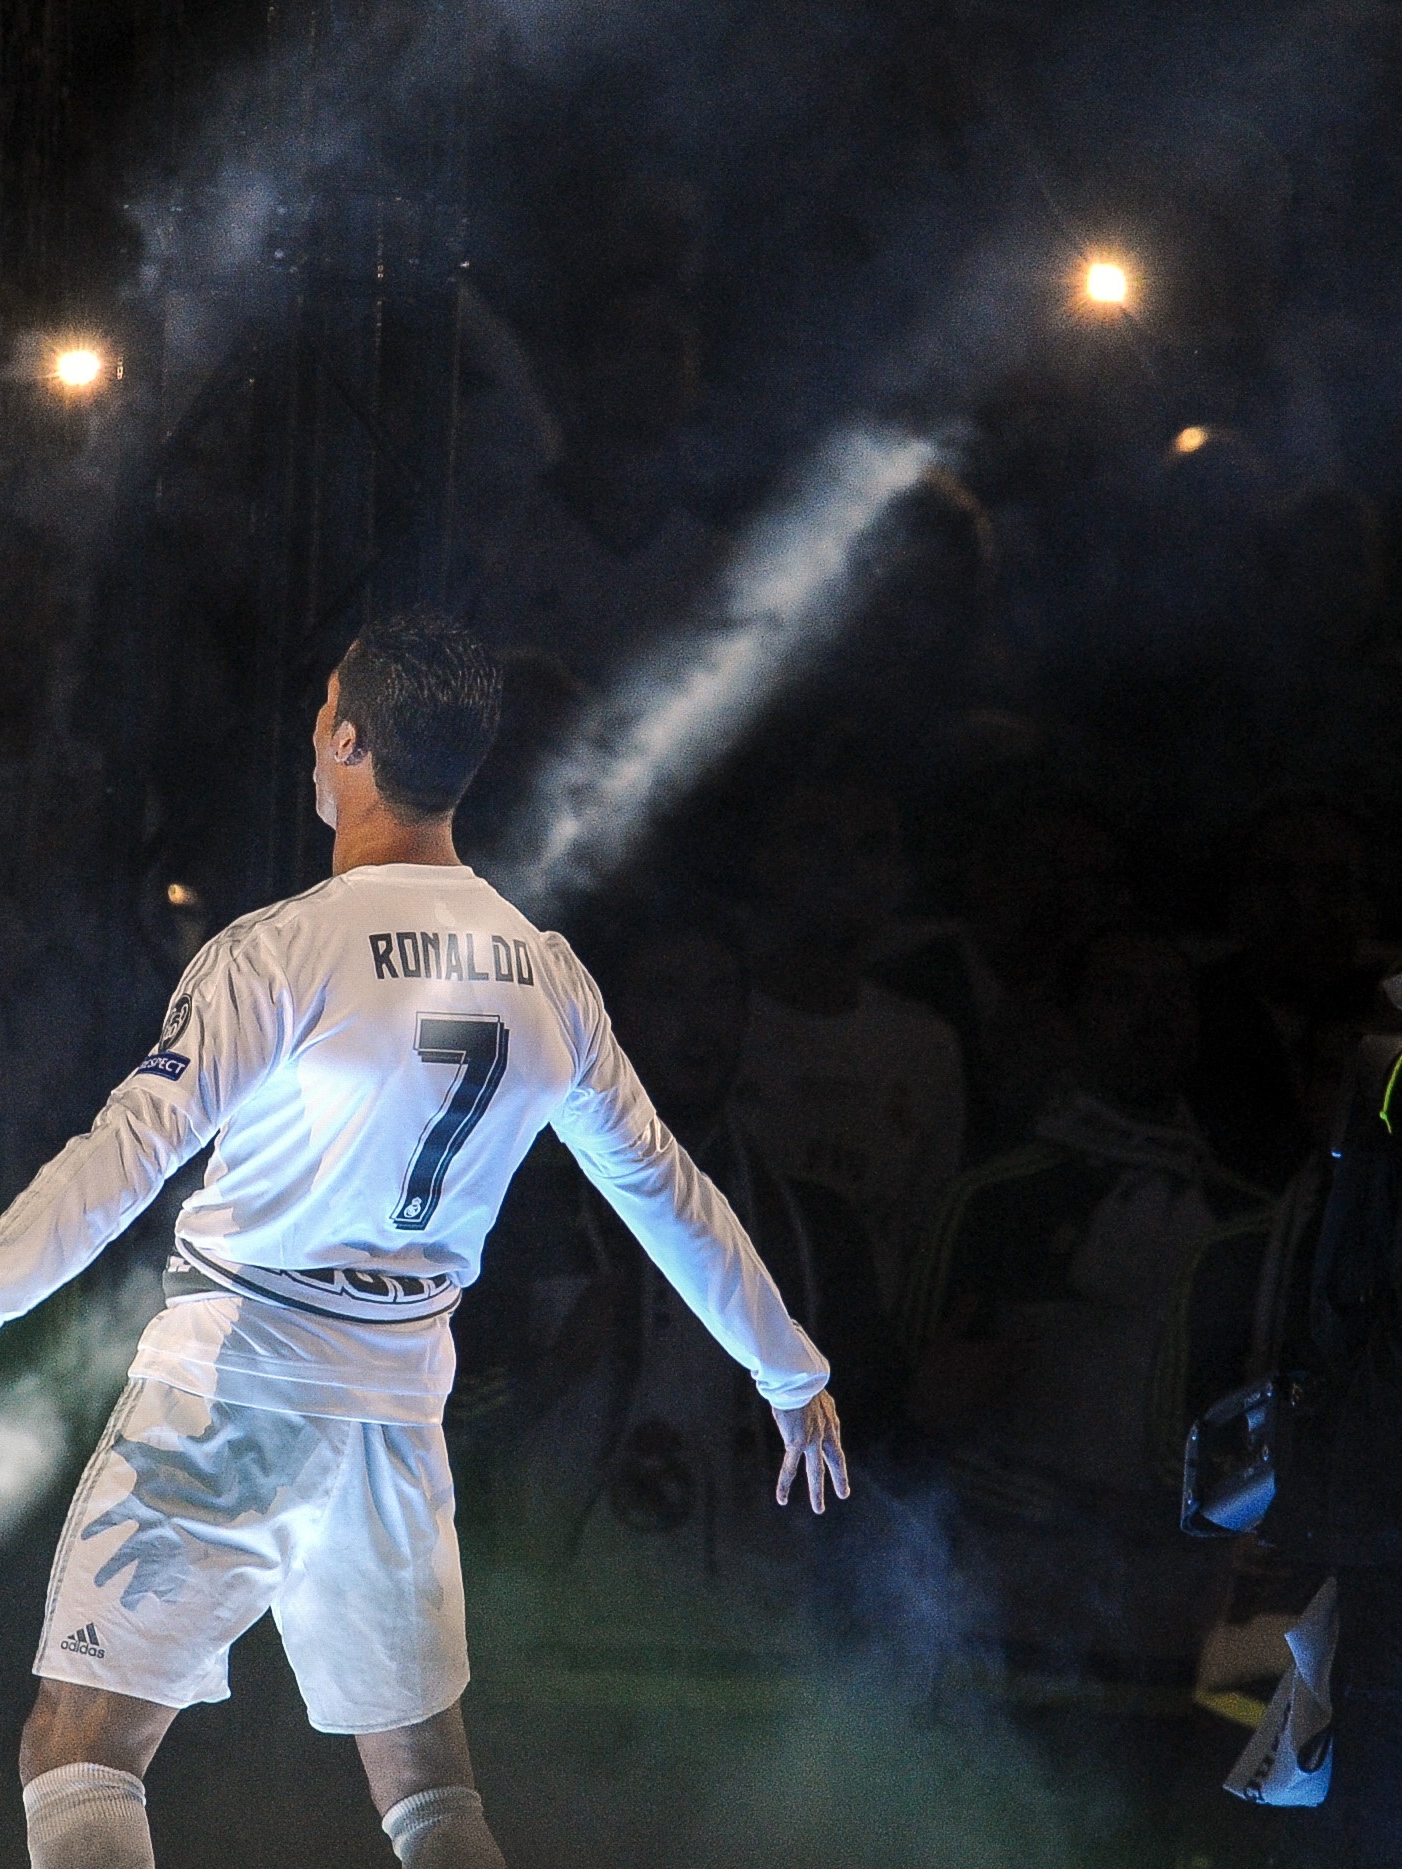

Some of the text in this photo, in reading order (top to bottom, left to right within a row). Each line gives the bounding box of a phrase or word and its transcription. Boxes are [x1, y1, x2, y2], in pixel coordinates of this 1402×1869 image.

[369, 931, 534, 987] RONALDO
[139, 1057, 185, 1074] ESPECT
[389, 1011, 510, 1231] 7
[60, 1640, 105, 1658] adidas
